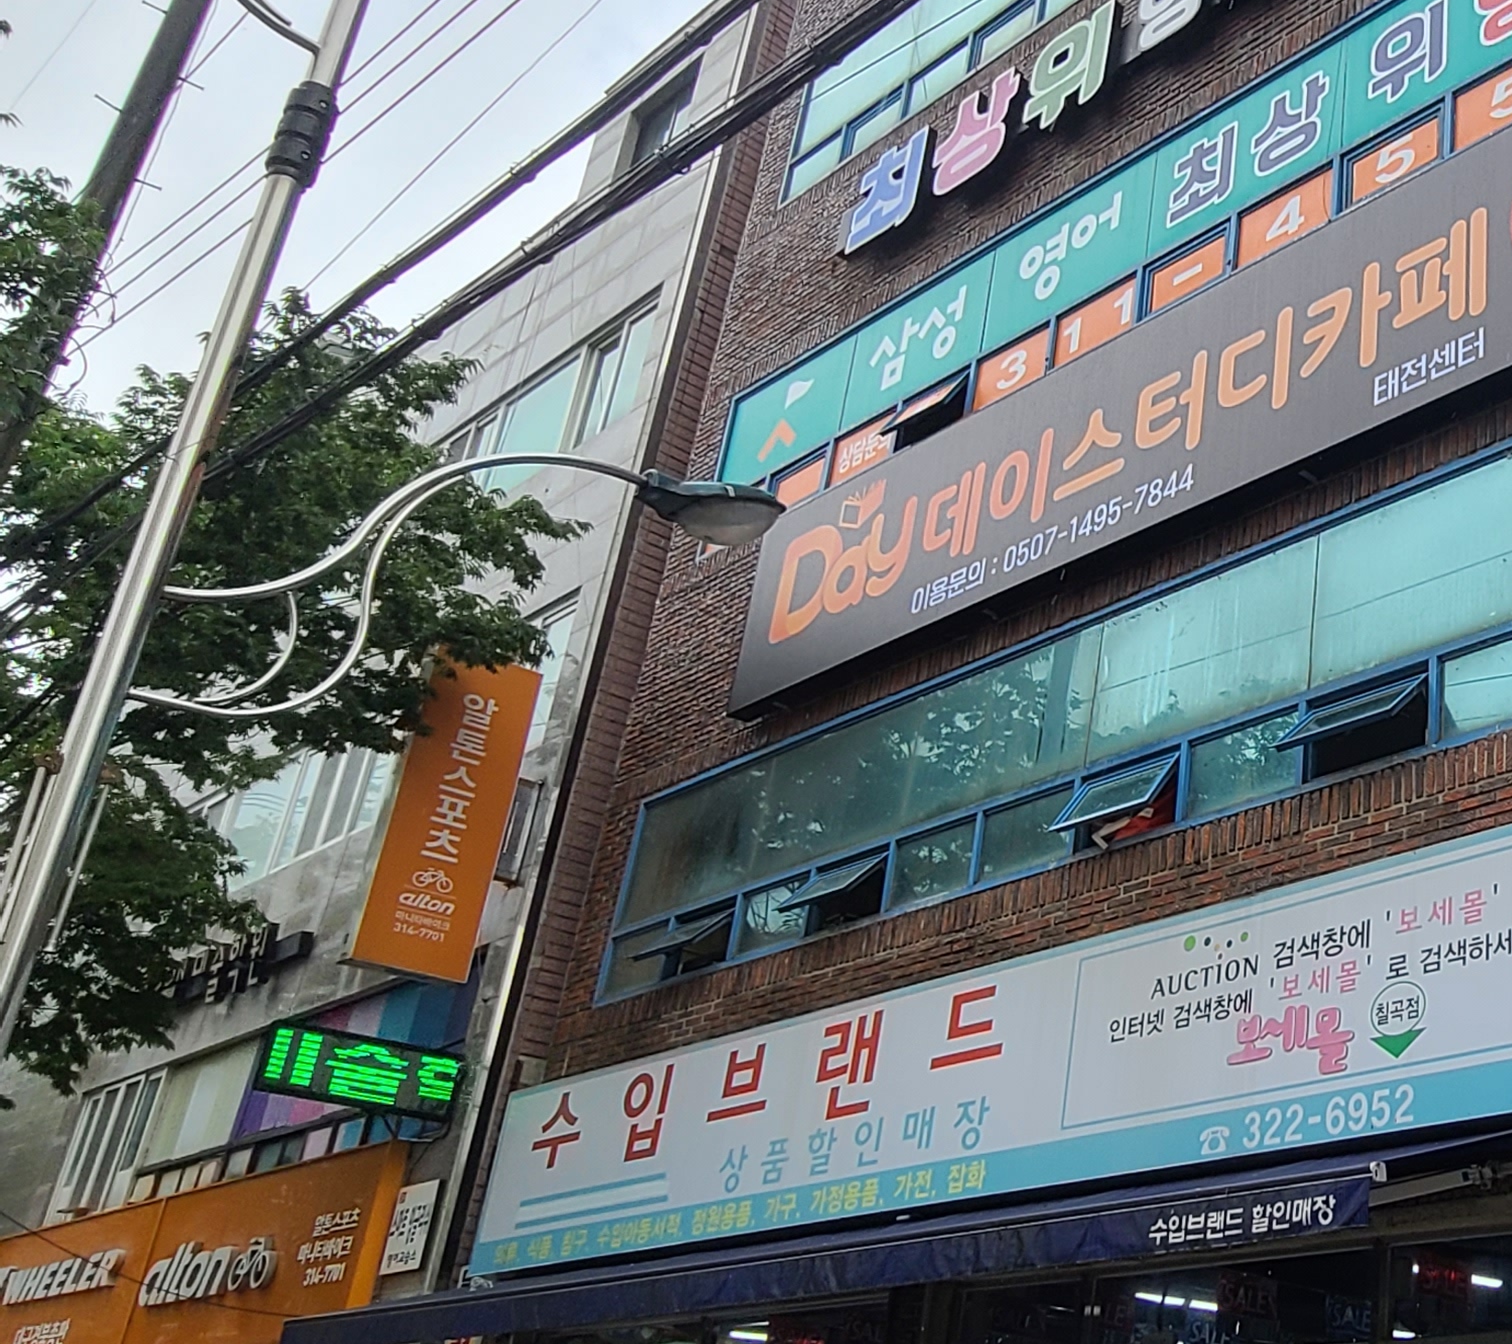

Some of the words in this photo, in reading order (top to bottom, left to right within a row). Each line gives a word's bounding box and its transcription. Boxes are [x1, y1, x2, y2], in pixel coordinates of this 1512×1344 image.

[869, 286, 967, 390] 삼성
[1019, 192, 1123, 300] 영어
[922, 206, 1488, 557] 데이스터디카페
[911, 566, 987, 614] 이용문의
[1003, 462, 1194, 573] 0507-1495-7844
[1373, 327, 1486, 405] 태전센터
[769, 497, 917, 644] Day
[420, 694, 499, 864] 알톤스포츠
[393, 922, 446, 944] 314-7701
[399, 892, 456, 916] alton
[1109, 1007, 1165, 1044] 인터넷
[1172, 988, 1253, 1030] 검색창에
[1386, 953, 1410, 981] 로
[1151, 953, 1259, 1000] AUCTION
[1273, 918, 1371, 969] 검색창에
[1227, 1005, 1355, 1075] 보세몰
[1375, 995, 1421, 1027] 칠곡점
[531, 984, 1004, 1170] 수입브랜드
[1243, 1084, 1415, 1149] 322-6952
[720, 1095, 992, 1194] 상품할인매장
[948, 1159, 986, 1194] 잡화
[312, 1207, 361, 1238] 알톤스포츠
[1148, 1206, 1244, 1246] 수입브랜드
[1252, 1194, 1337, 1234] 할인매장
[0, 1247, 126, 1306] WHEELER
[138, 1239, 240, 1308] alton
[303, 1262, 347, 1287] 314-7701
